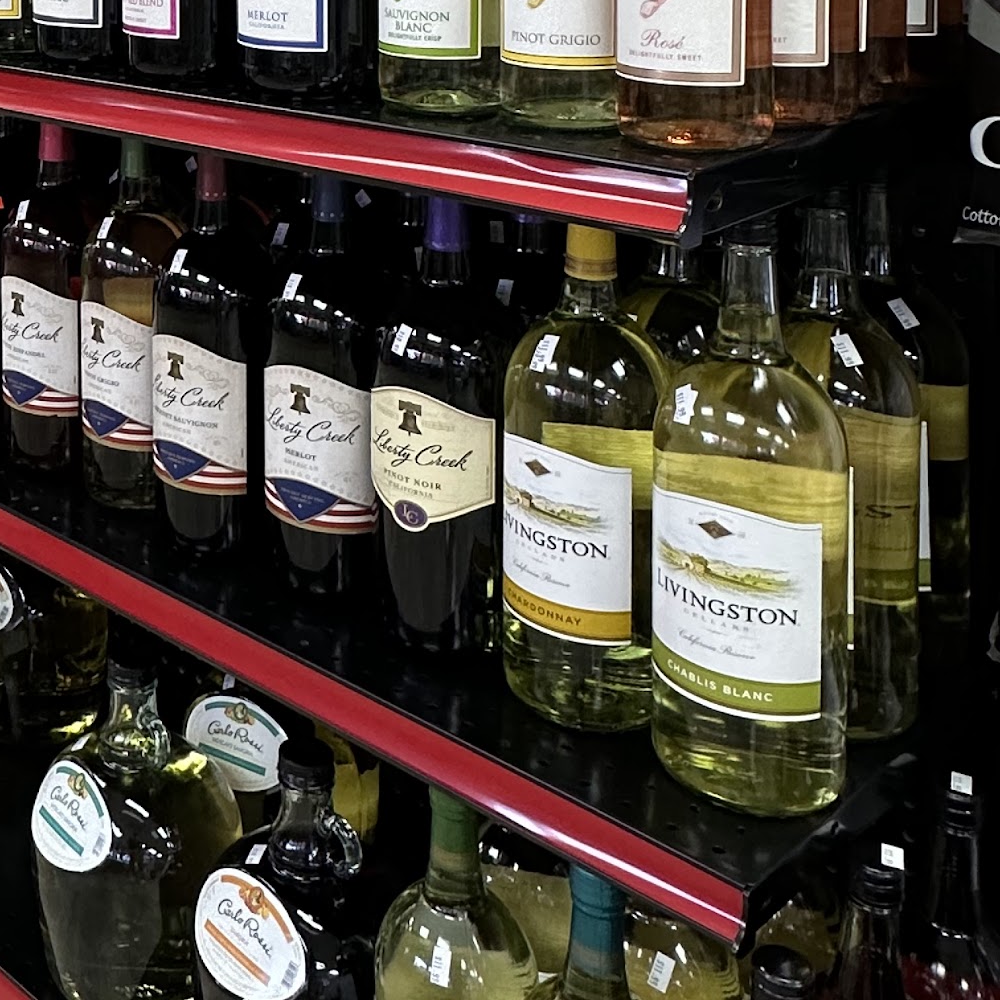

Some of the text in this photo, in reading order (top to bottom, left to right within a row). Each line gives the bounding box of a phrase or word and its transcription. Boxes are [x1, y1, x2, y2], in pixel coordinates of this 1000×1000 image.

[247, 9, 289, 23] MERLOT
[384, 9, 450, 22] SAUVIGNON
[395, 21, 433, 34] BLANC
[511, 30, 601, 46] PINOT GRIGIO
[640, 28, 685, 49] Rosé
[677, 53, 703, 62] SWEET
[21, 322, 64, 343] Creek
[101, 350, 146, 373] Creek
[180, 387, 230, 411] Creek
[266, 407, 361, 445] Liberty Creek
[285, 447, 317, 462] MERLOT
[372, 428, 474, 472] Liberty Creek
[383, 467, 442, 491] PINOT NOIR
[503, 509, 609, 559] IVINGSTON
[507, 588, 582, 627] CHARDONNAY
[657, 567, 798, 627] LIVINGSTON
[667, 658, 774, 704] CHABLIS BLANC
[207, 720, 264, 752] Carlo Rossi
[50, 785, 69, 808] Carlo
[217, 897, 272, 958] Carlo Rossi
